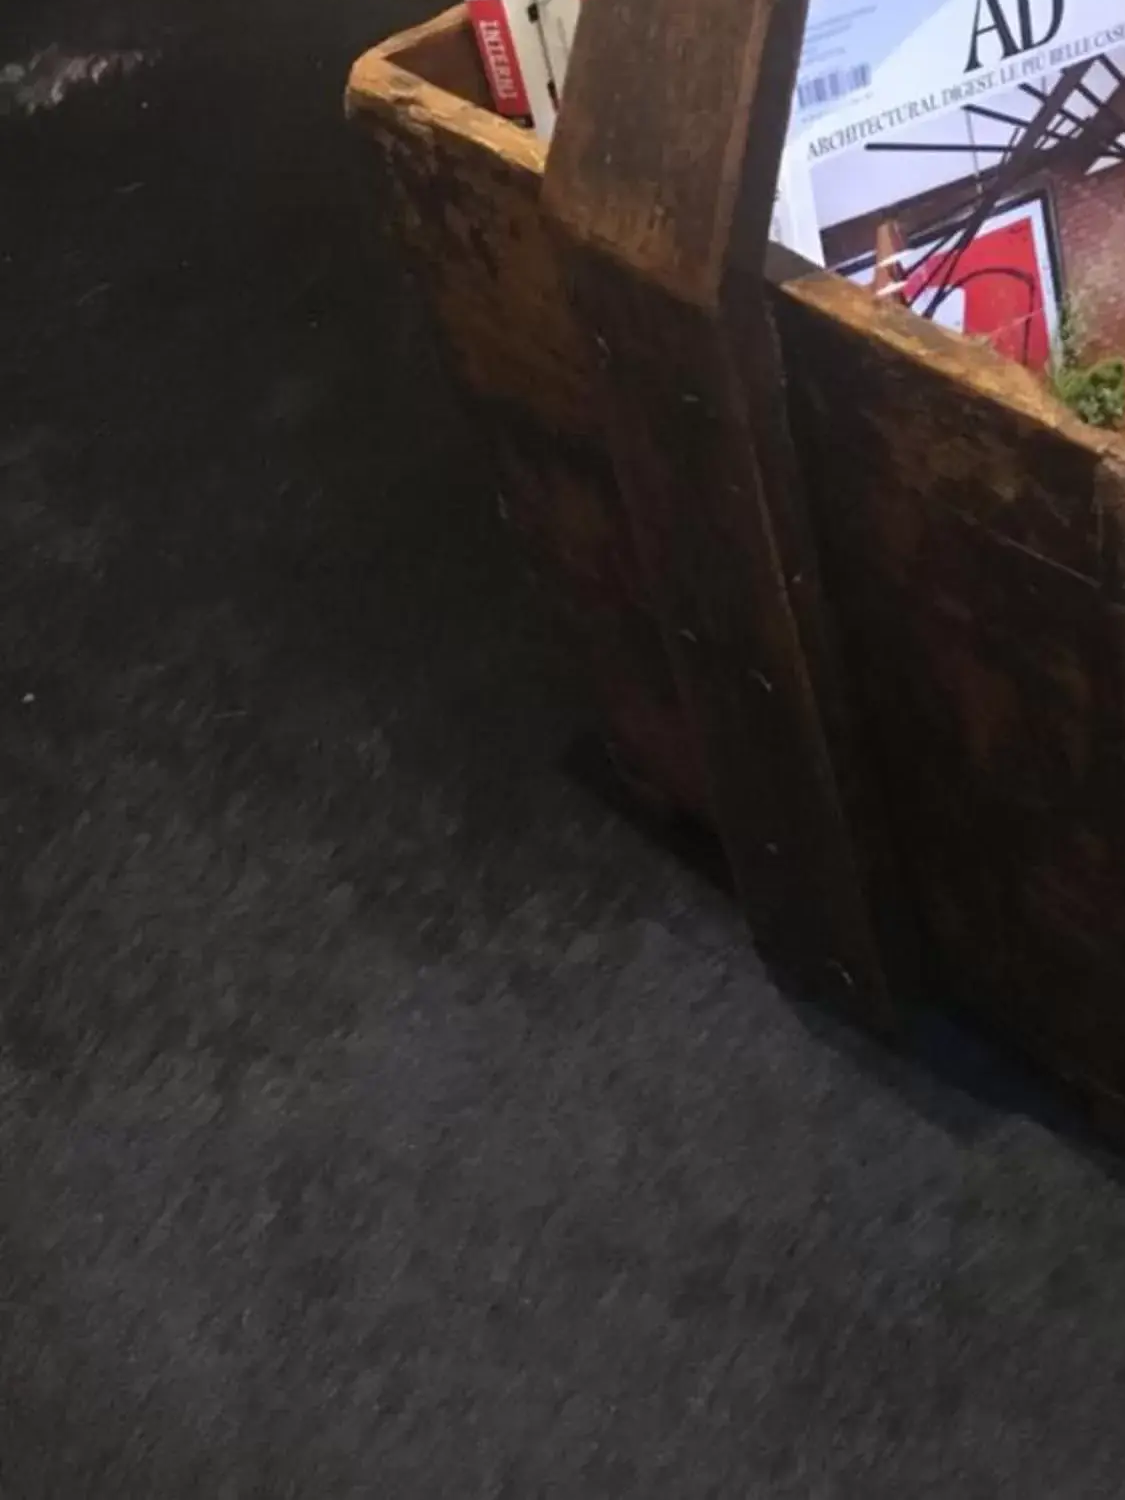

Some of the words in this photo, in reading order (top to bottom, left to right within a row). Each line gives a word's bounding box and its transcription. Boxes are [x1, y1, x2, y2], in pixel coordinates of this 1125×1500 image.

[807, 93, 939, 161] ARCHITECTURAL
[1000, 62, 1016, 83] LE
[1050, 37, 1091, 66] BELLE
[1093, 23, 1125, 49] CASE
